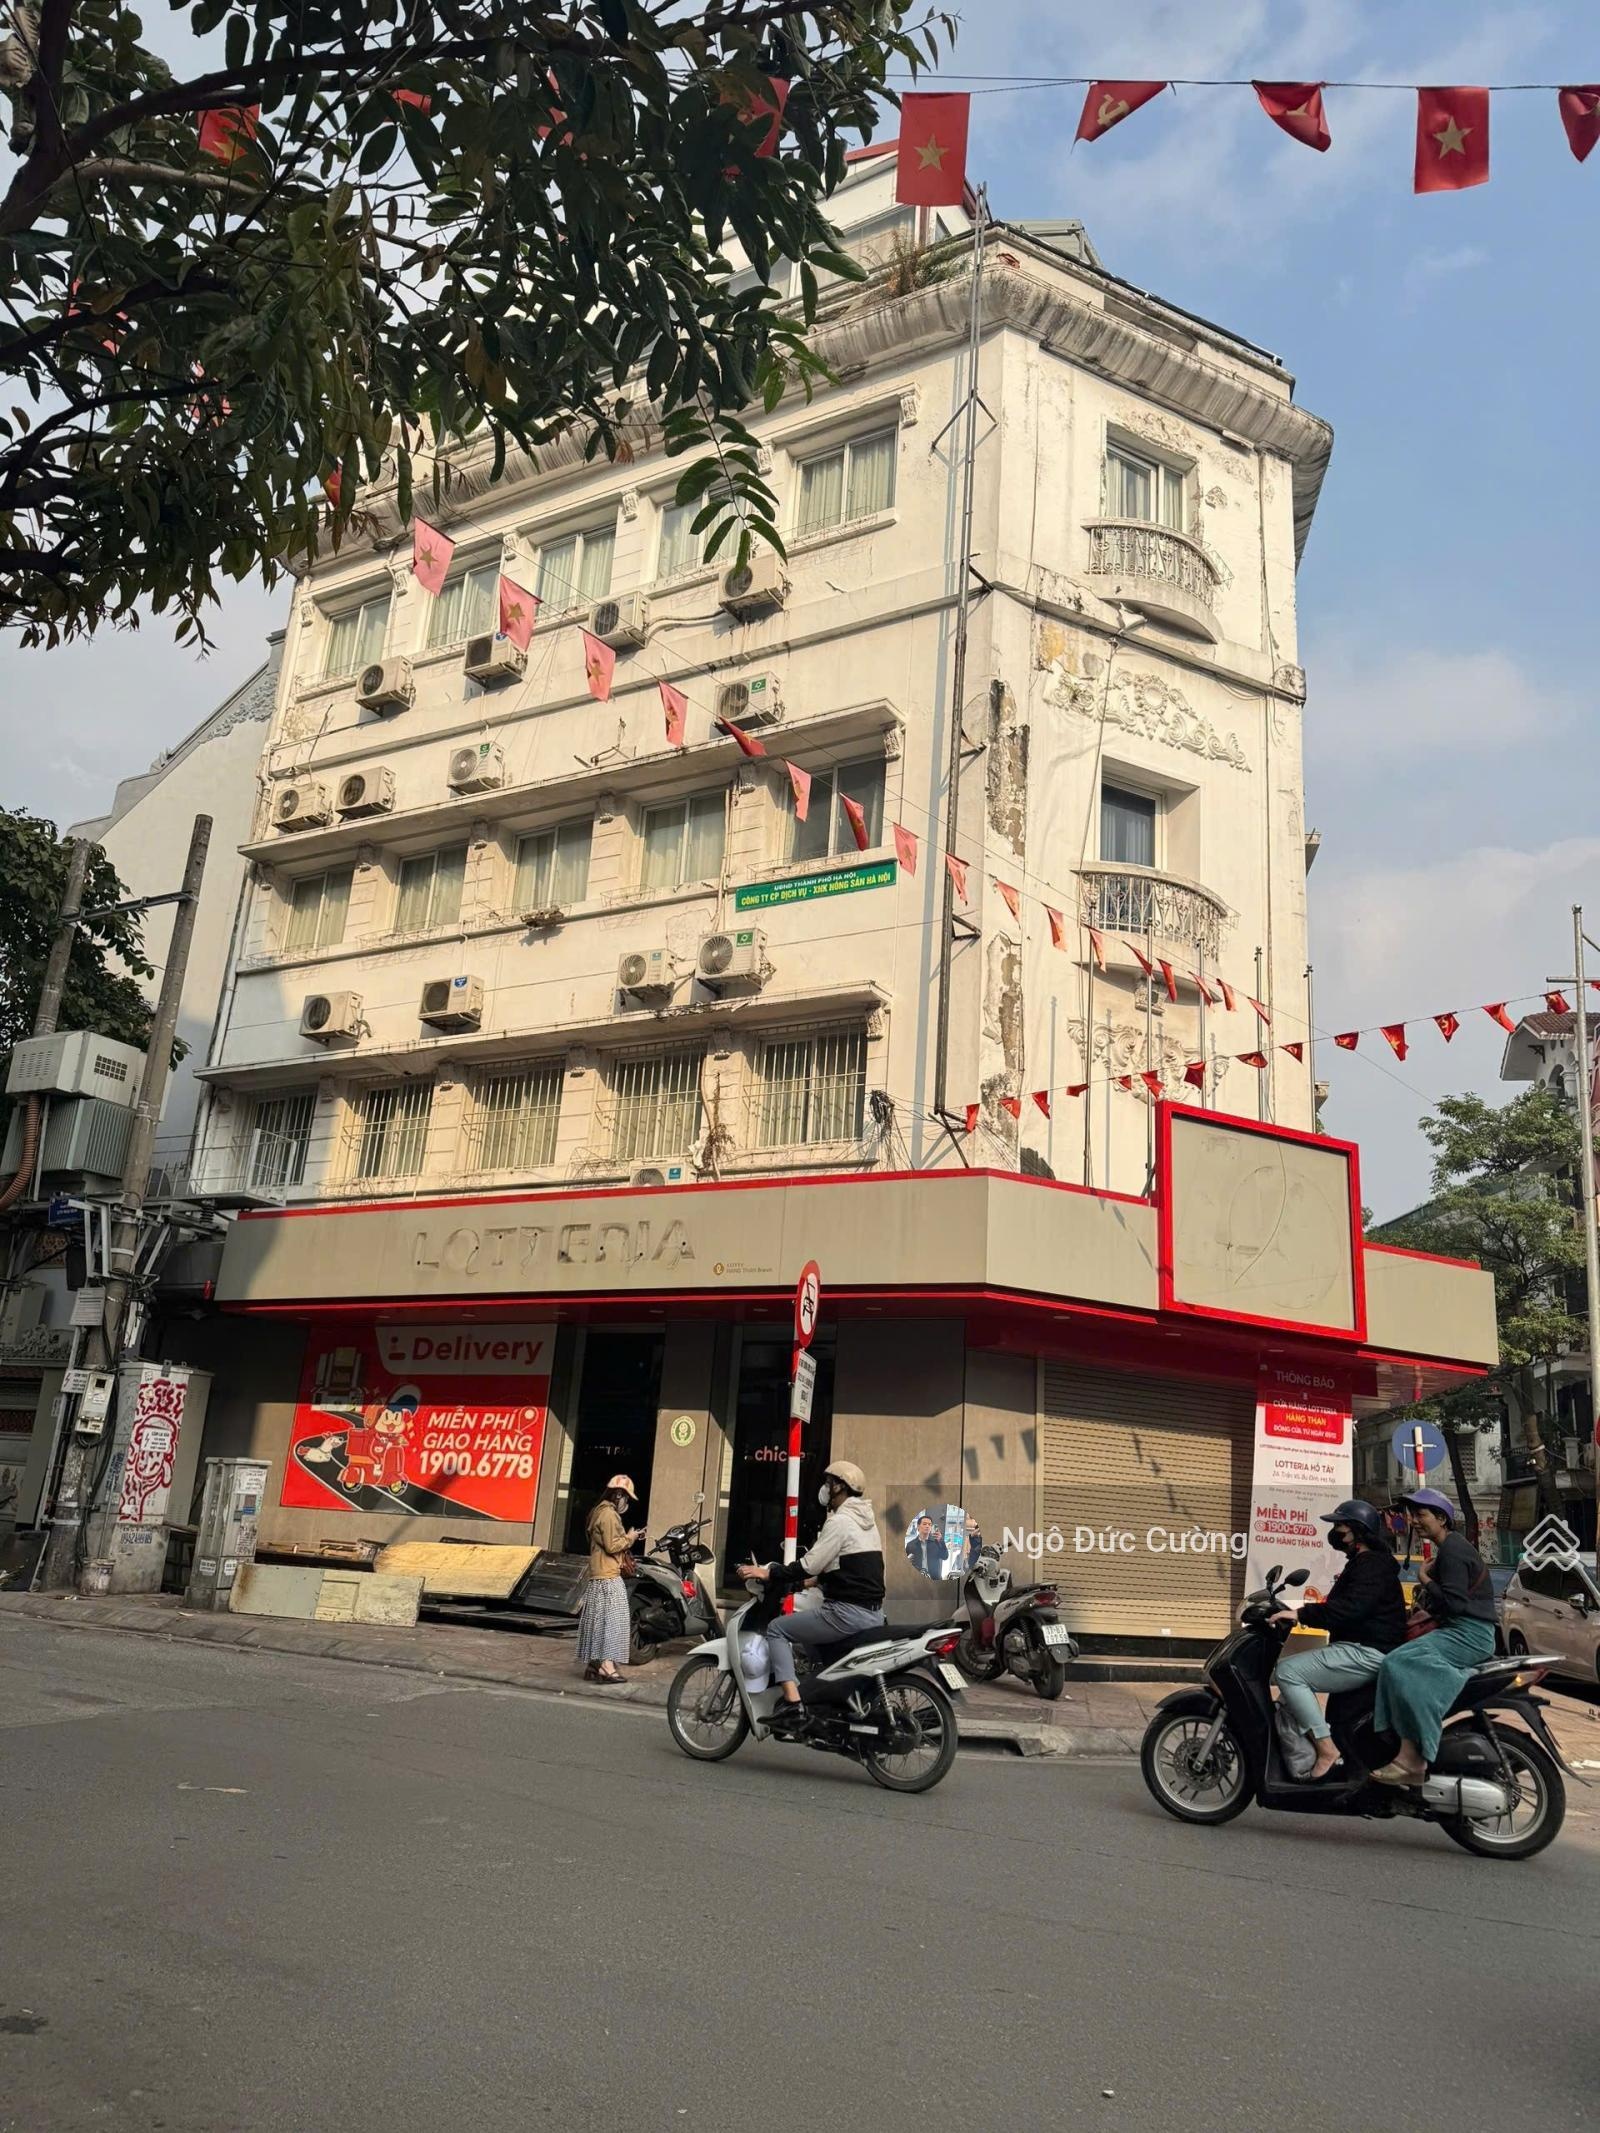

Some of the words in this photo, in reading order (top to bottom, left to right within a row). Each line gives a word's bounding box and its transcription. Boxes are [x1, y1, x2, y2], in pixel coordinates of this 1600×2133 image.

[741, 895, 760, 906] CÔNG
[760, 893, 769, 902] TY
[770, 892, 779, 901] CP
[798, 888, 807, 898] VỤ
[829, 881, 849, 892] NÔNG
[850, 877, 865, 888] SẢN
[866, 874, 876, 885] HÀ
[878, 872, 890, 884] NỘI
[412, 1329, 545, 1366] Delivery
[1273, 1369, 1312, 1386] THÔNG
[1313, 1376, 1336, 1390] BÁO
[427, 1405, 477, 1429] MIỄN
[480, 1408, 519, 1430] PHÍ
[423, 1432, 471, 1449] GIAO
[473, 1431, 533, 1452] HÀNG
[419, 1450, 534, 1479] 1900.6778
[1274, 1460, 1309, 1471] LOTTERIA
[1256, 1503, 1287, 1520] MIỄN
[1290, 1508, 1308, 1522] PHÍ
[1267, 1520, 1315, 1536] 1900-6778
[1255, 1535, 1275, 1543] GIAO
[1276, 1535, 1297, 1546] HÀNG
[1298, 1538, 1311, 1549] TẬN
[1311, 1539, 1324, 1548] NƠI
